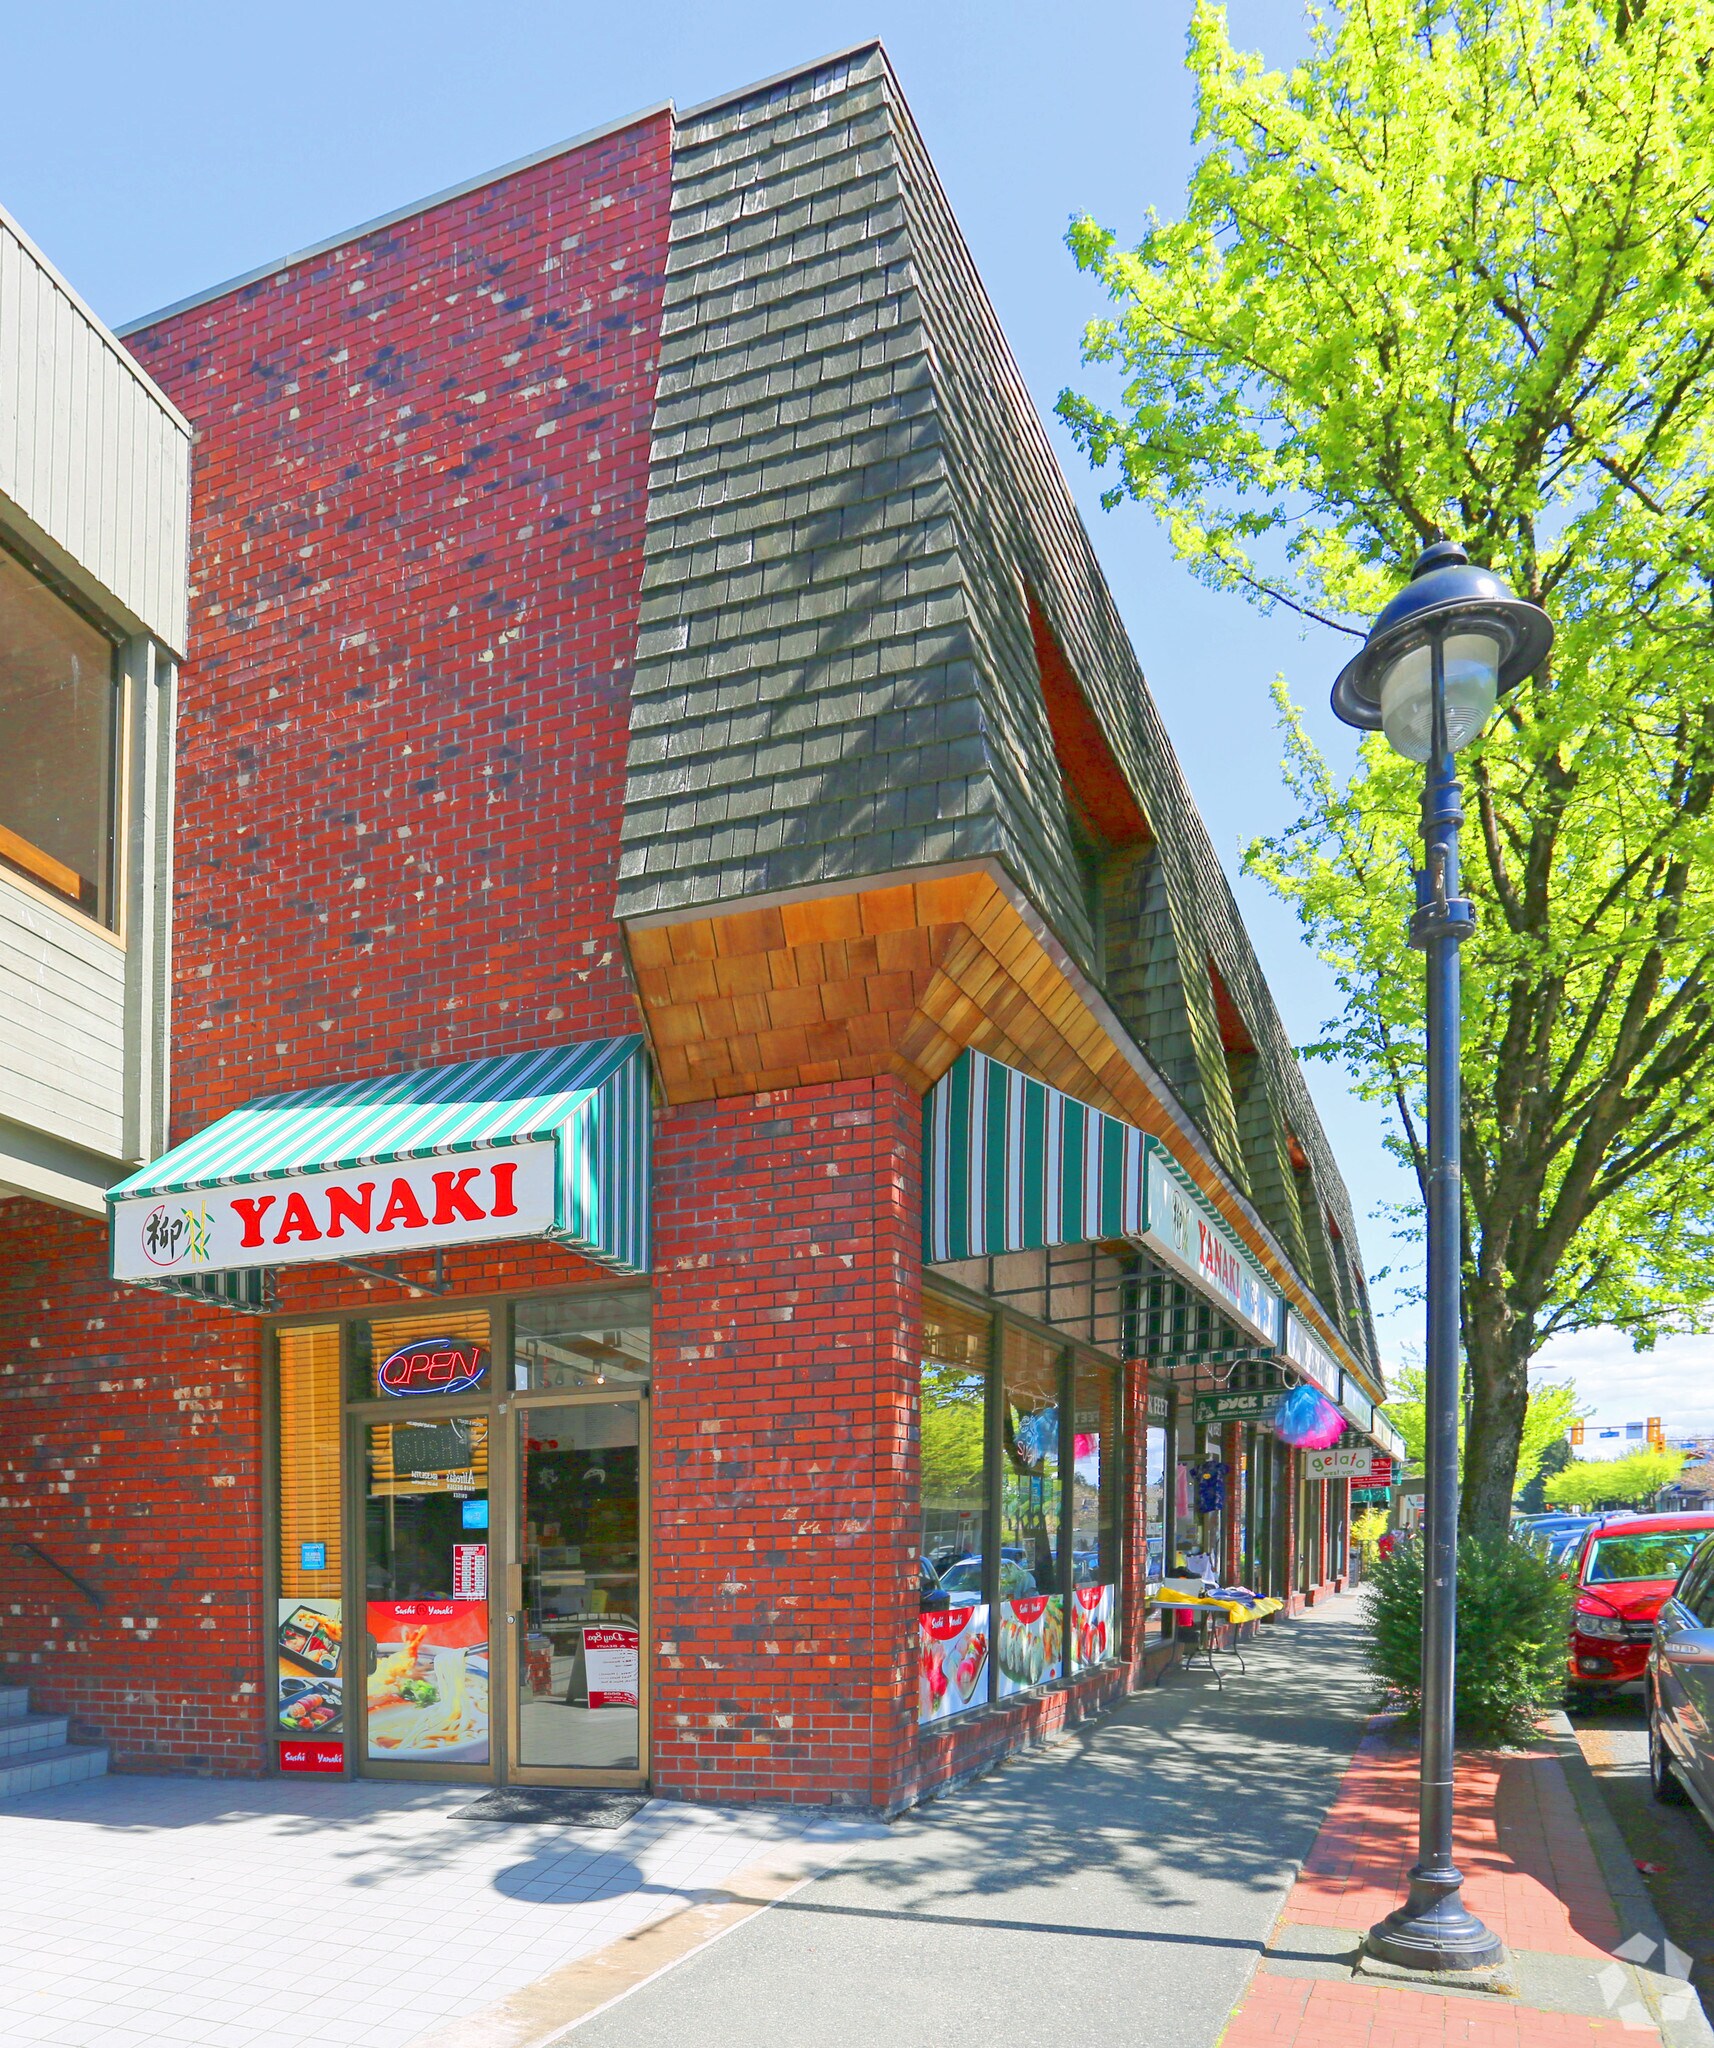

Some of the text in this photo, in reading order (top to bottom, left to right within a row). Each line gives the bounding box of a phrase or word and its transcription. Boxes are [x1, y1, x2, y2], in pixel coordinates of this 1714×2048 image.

[230, 1162, 518, 1249] YANAKI
[1197, 1219, 1241, 1300] YANAKI
[382, 1347, 480, 1385] OPEN
[1217, 1395, 1258, 1411] DUCK
[401, 1437, 460, 1463] SUSHI
[1312, 1451, 1366, 1472] gelato
[394, 1604, 454, 1617] Sushi Yanaki
[285, 1751, 343, 1764] Sushi Yanaki
